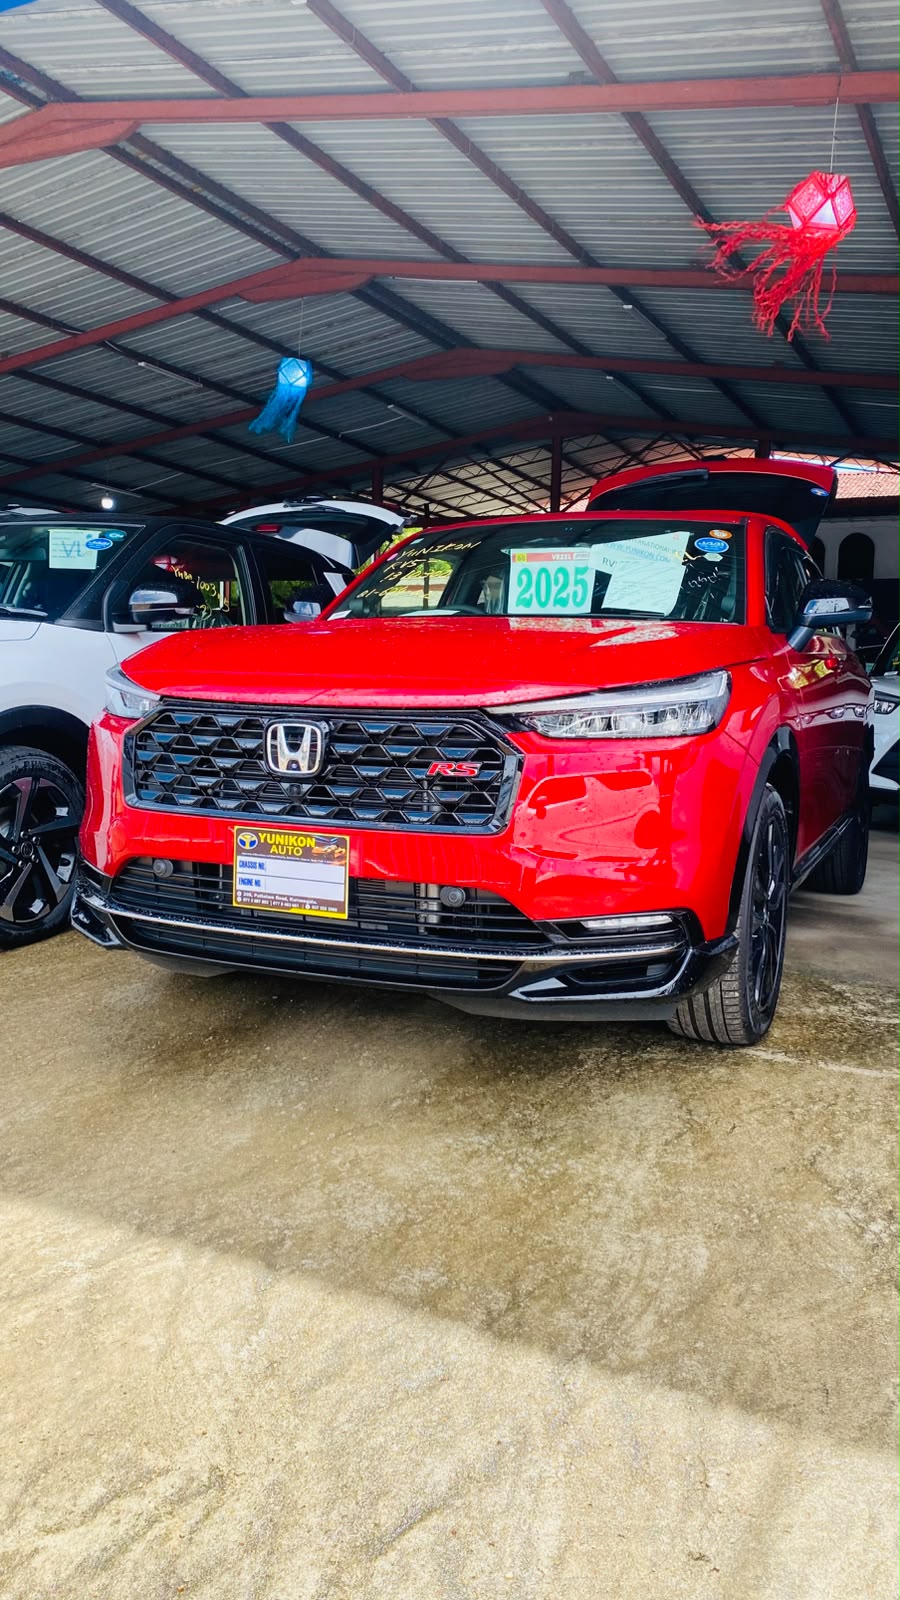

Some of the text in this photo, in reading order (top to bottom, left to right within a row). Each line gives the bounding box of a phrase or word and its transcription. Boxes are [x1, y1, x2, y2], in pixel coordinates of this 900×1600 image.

[515, 566, 589, 609] 2025
[426, 760, 482, 777] RS
[258, 832, 316, 848] YUNIKON
[270, 845, 302, 856] AUTO
[239, 860, 257, 870] CHASSIS
[239, 878, 253, 886] ENGINE
